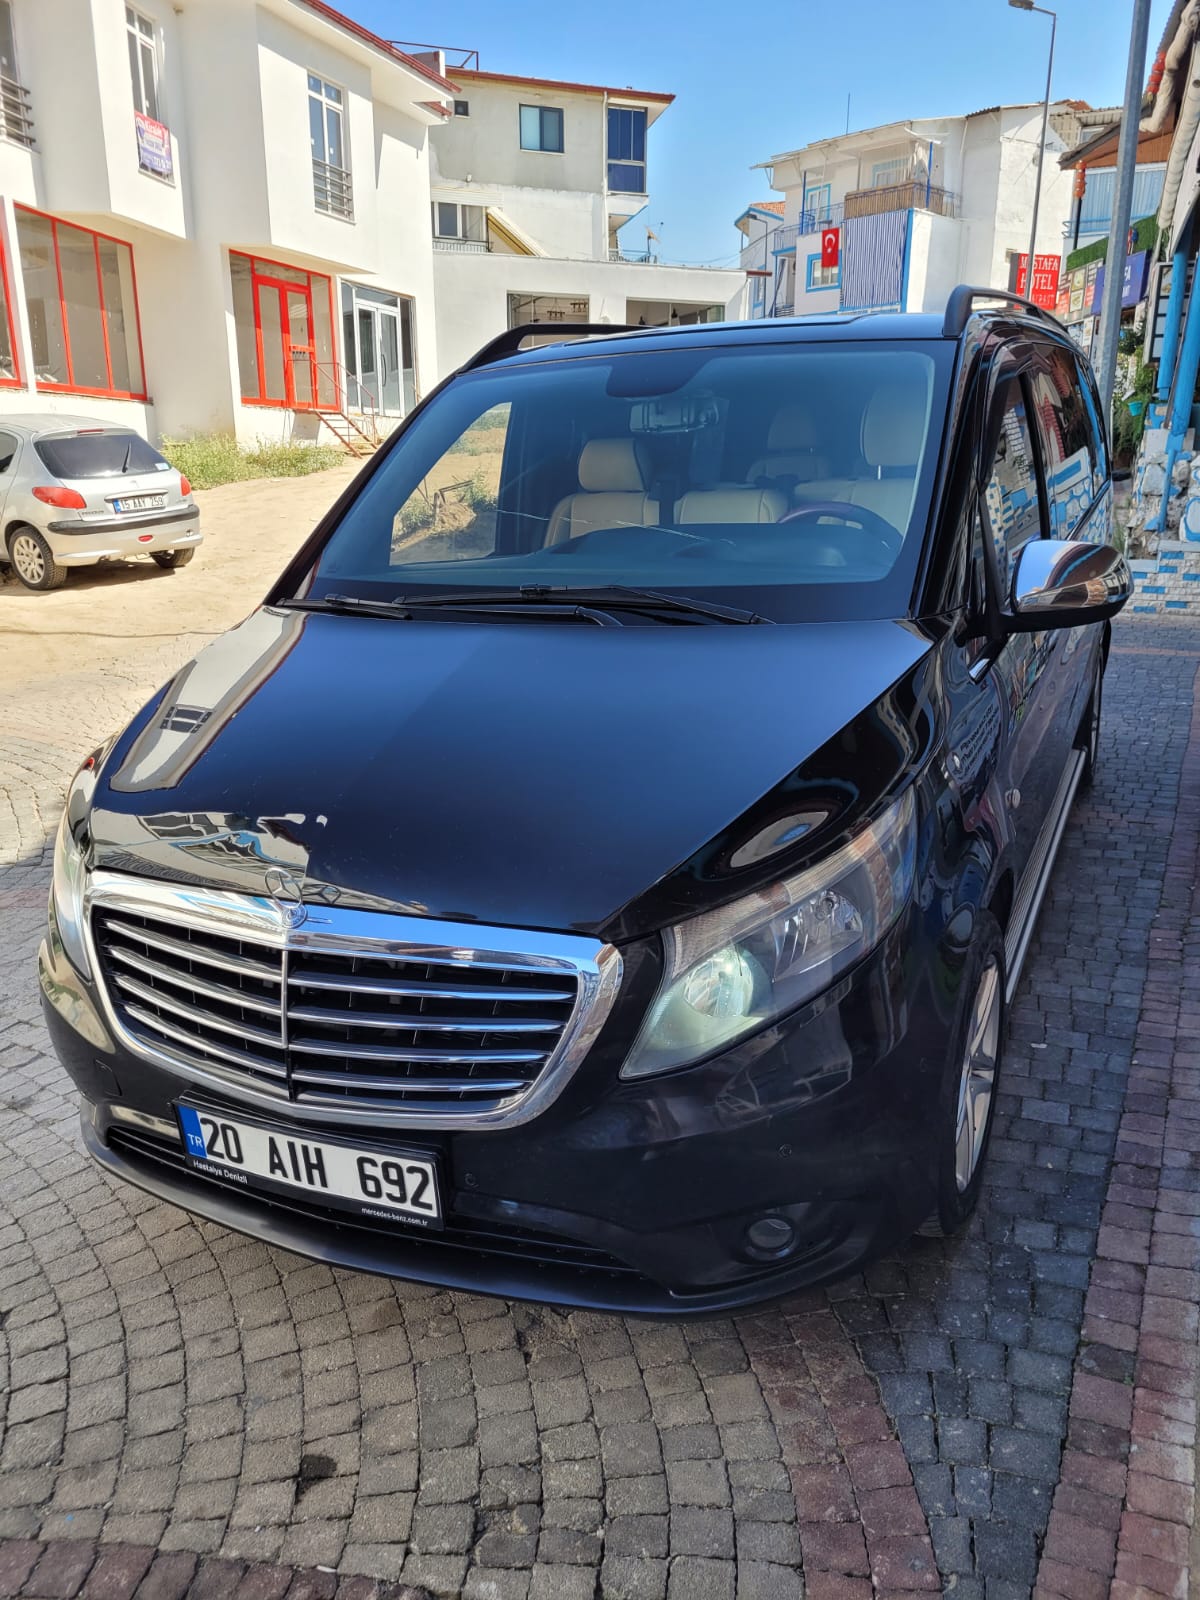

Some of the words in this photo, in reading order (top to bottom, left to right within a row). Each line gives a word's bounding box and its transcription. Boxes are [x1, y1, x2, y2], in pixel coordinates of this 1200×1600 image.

[1021, 256, 1058, 271] MSTAFA
[187, 1133, 203, 1148] TR
[200, 1117, 244, 1164] 20
[268, 1136, 328, 1188] AIH
[356, 1156, 433, 1210] 692
[224, 1170, 248, 1184] Denizli
[361, 1207, 428, 1226] mercedes-benz.com.tr
